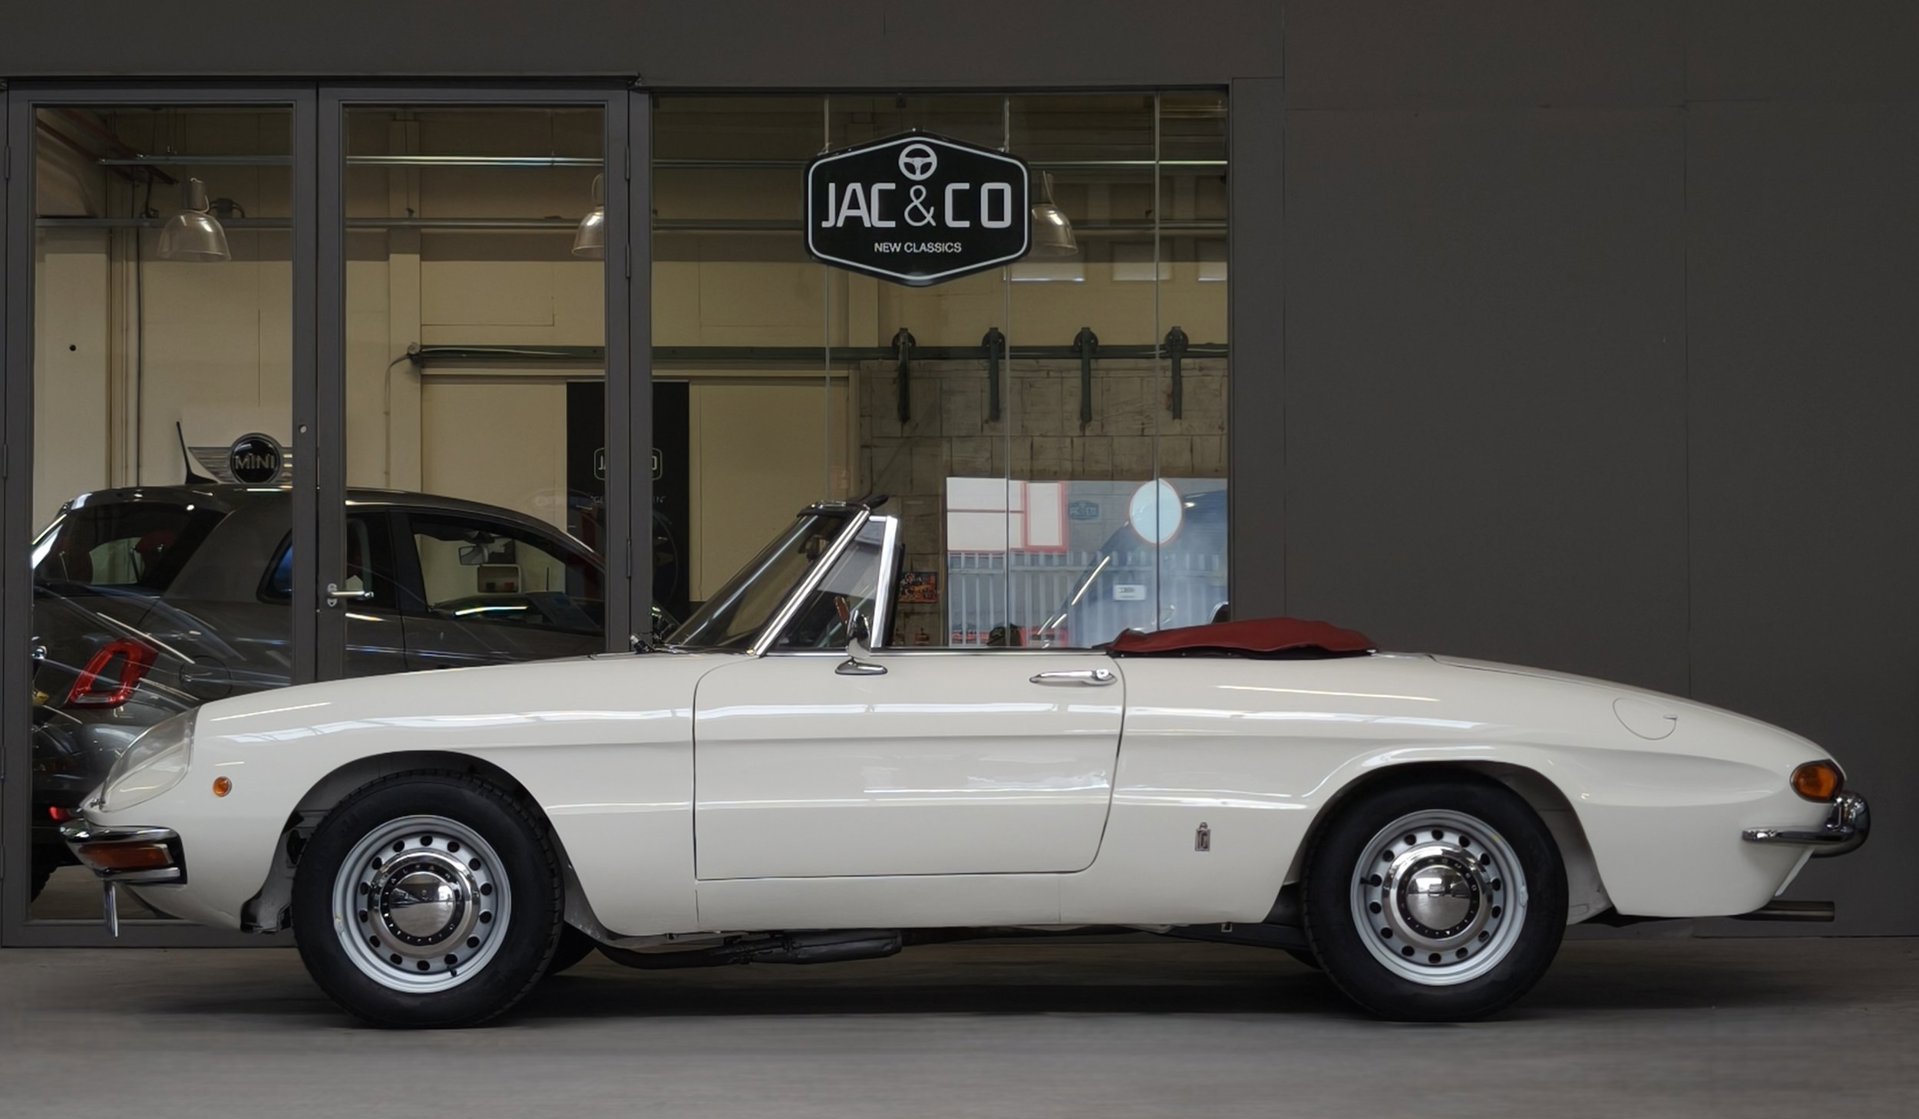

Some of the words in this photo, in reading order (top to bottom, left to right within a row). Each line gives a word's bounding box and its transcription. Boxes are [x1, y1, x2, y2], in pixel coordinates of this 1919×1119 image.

[874, 242, 902, 254] NEW
[904, 242, 962, 254] CLASSICS
[234, 453, 276, 470] MINI
